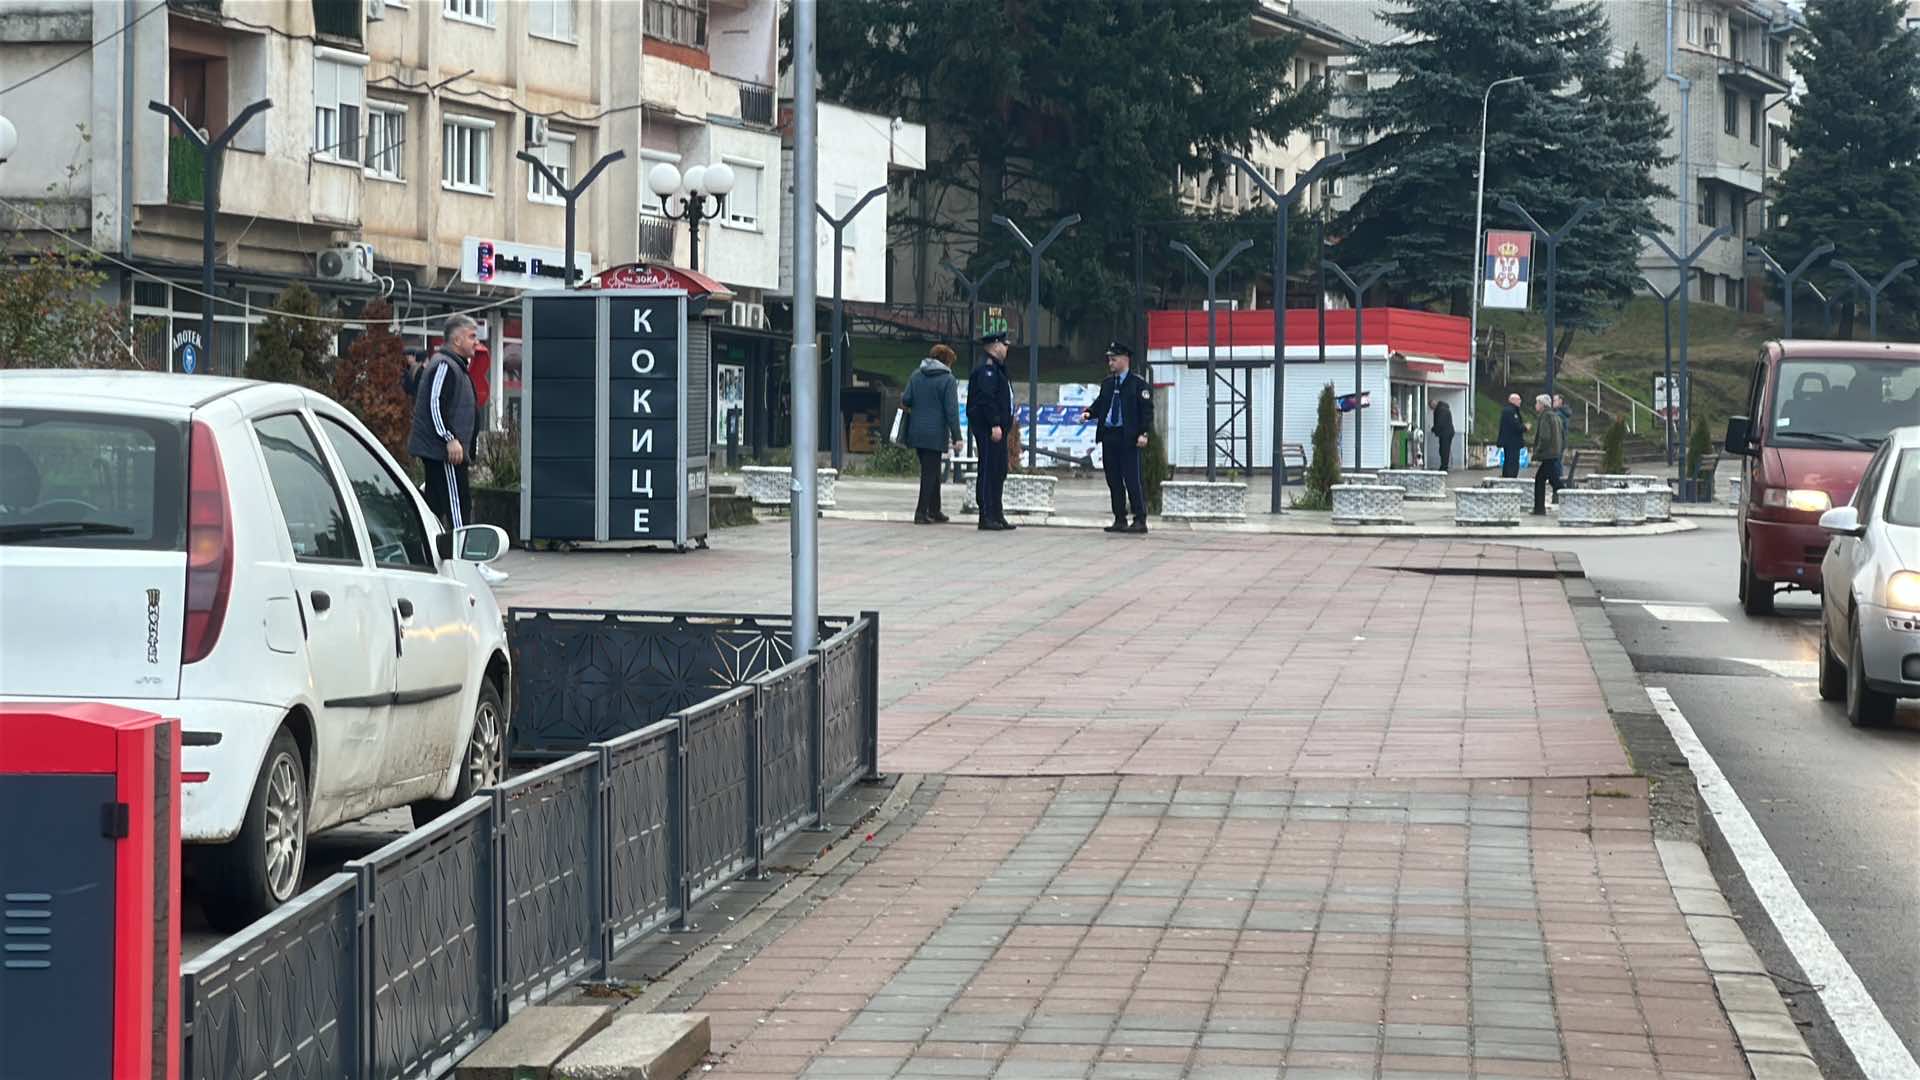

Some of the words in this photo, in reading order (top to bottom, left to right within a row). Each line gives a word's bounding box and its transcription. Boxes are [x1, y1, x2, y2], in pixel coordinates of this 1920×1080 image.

[173, 329, 204, 352] АПОТЕК
[631, 308, 655, 533] КОКИЦЕ
[147, 604, 159, 664] MONSTER
